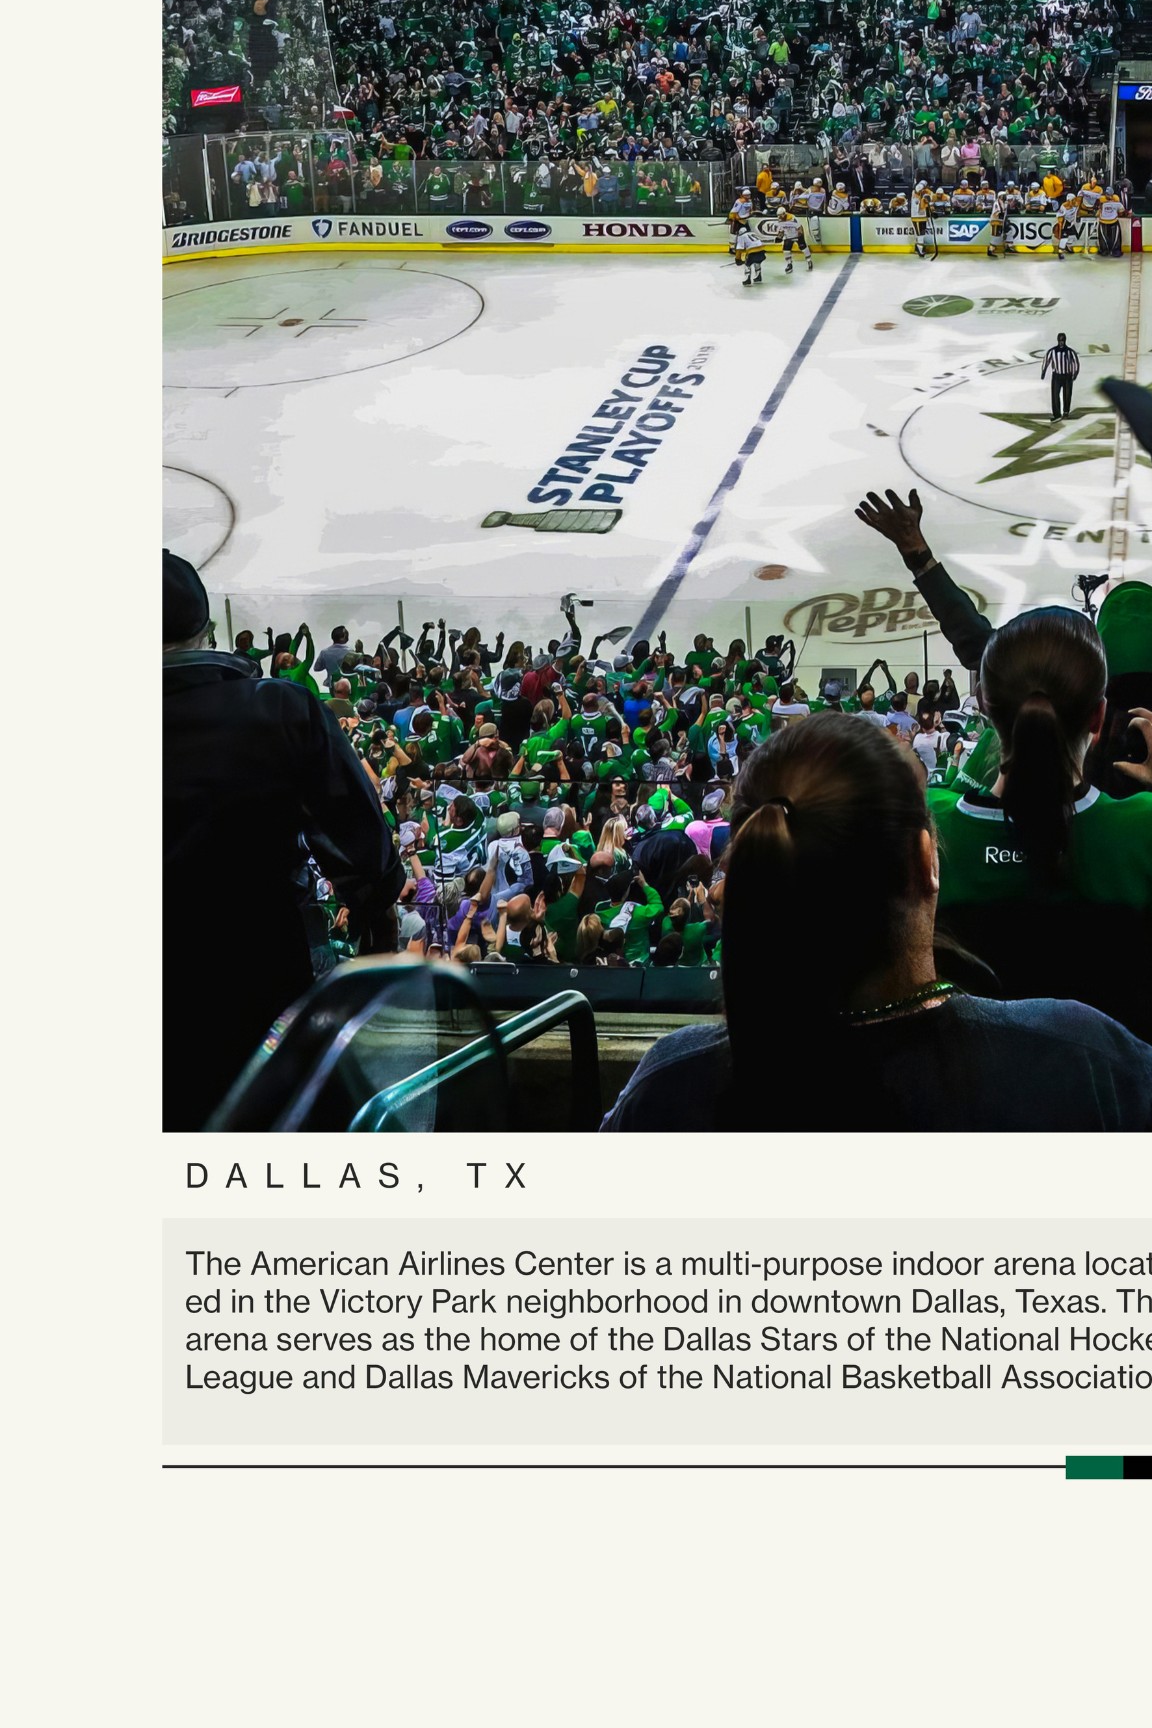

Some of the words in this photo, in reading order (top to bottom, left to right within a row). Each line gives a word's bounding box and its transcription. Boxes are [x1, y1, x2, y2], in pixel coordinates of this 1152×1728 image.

[171, 224, 293, 248] BRIDGESTONE
[338, 221, 424, 237] FANDUEL
[583, 223, 695, 238] HONDA
[949, 223, 980, 238] SAP
[978, 297, 1060, 309] TXU
[527, 388, 644, 506] STANLEY
[620, 344, 677, 389] CUP
[578, 372, 706, 504] PLAYOFFS
[790, 593, 937, 639] Peppe
